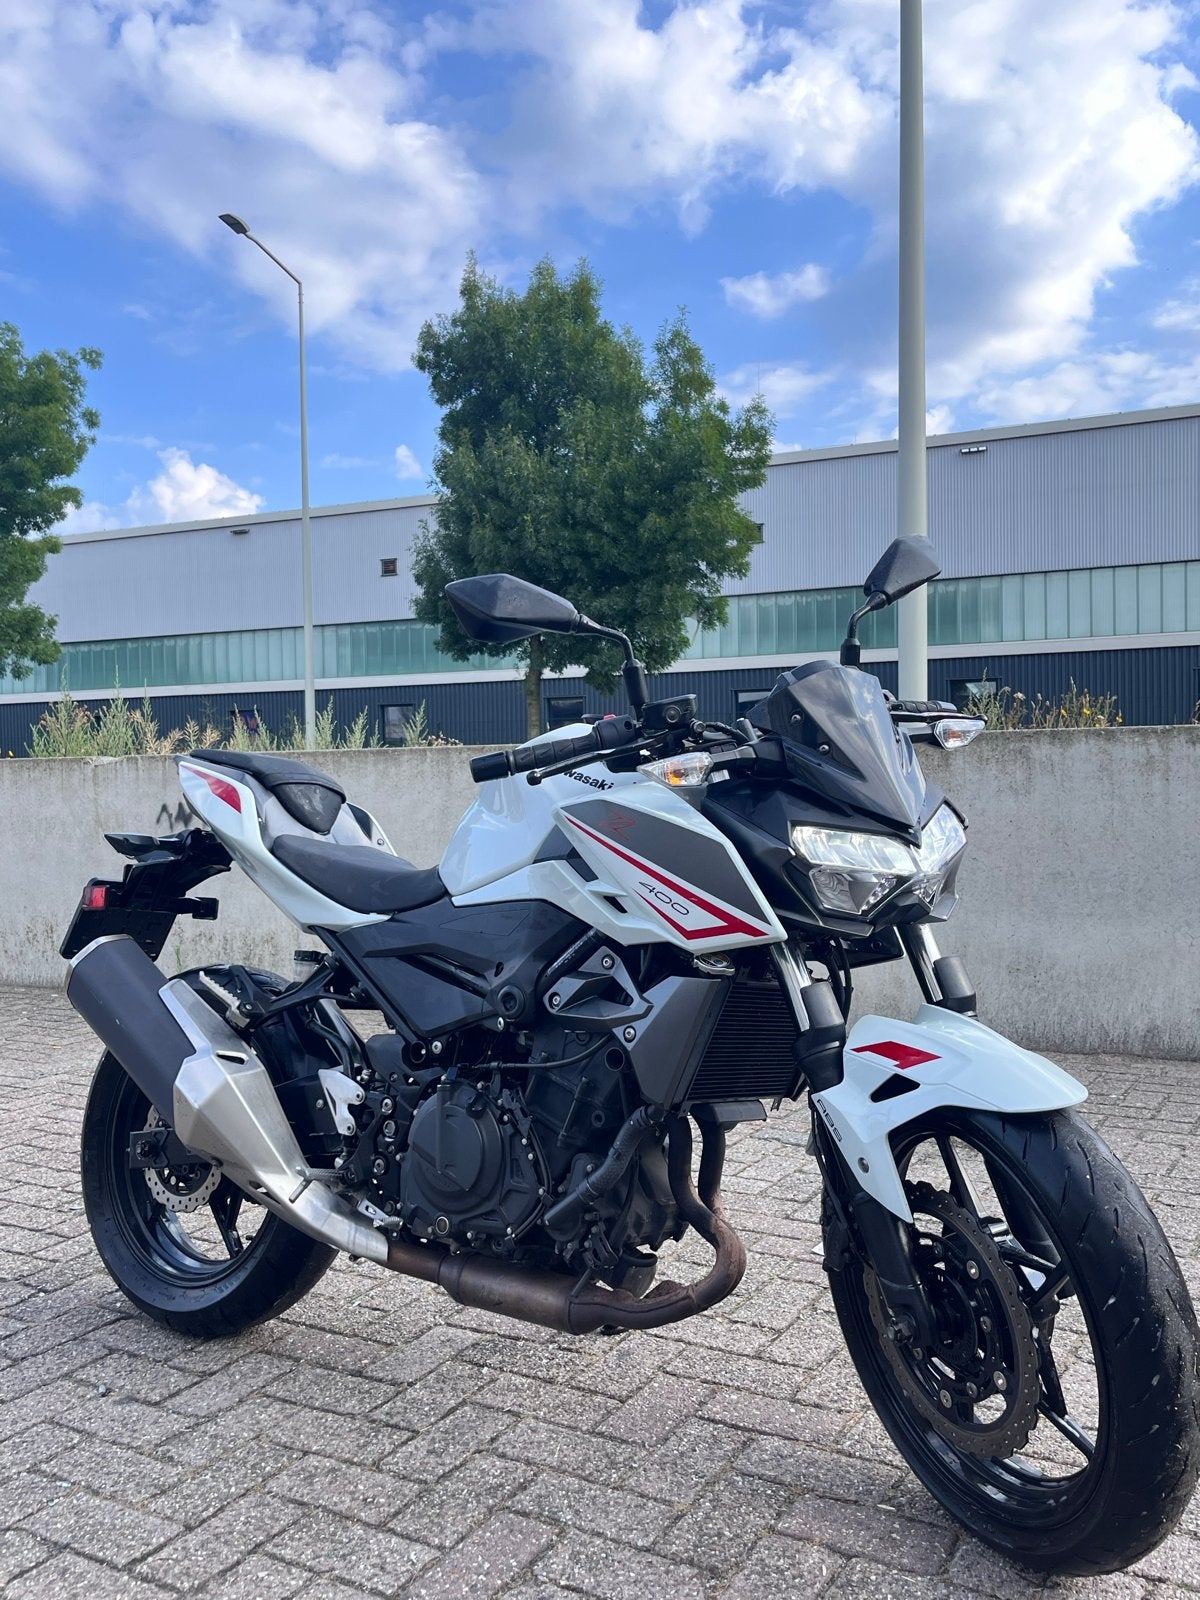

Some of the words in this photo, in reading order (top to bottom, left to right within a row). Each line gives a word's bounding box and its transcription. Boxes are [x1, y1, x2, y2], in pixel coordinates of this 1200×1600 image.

[563, 769, 615, 790] wasaki
[638, 881, 690, 916] 400
[817, 1098, 843, 1142] ABS
